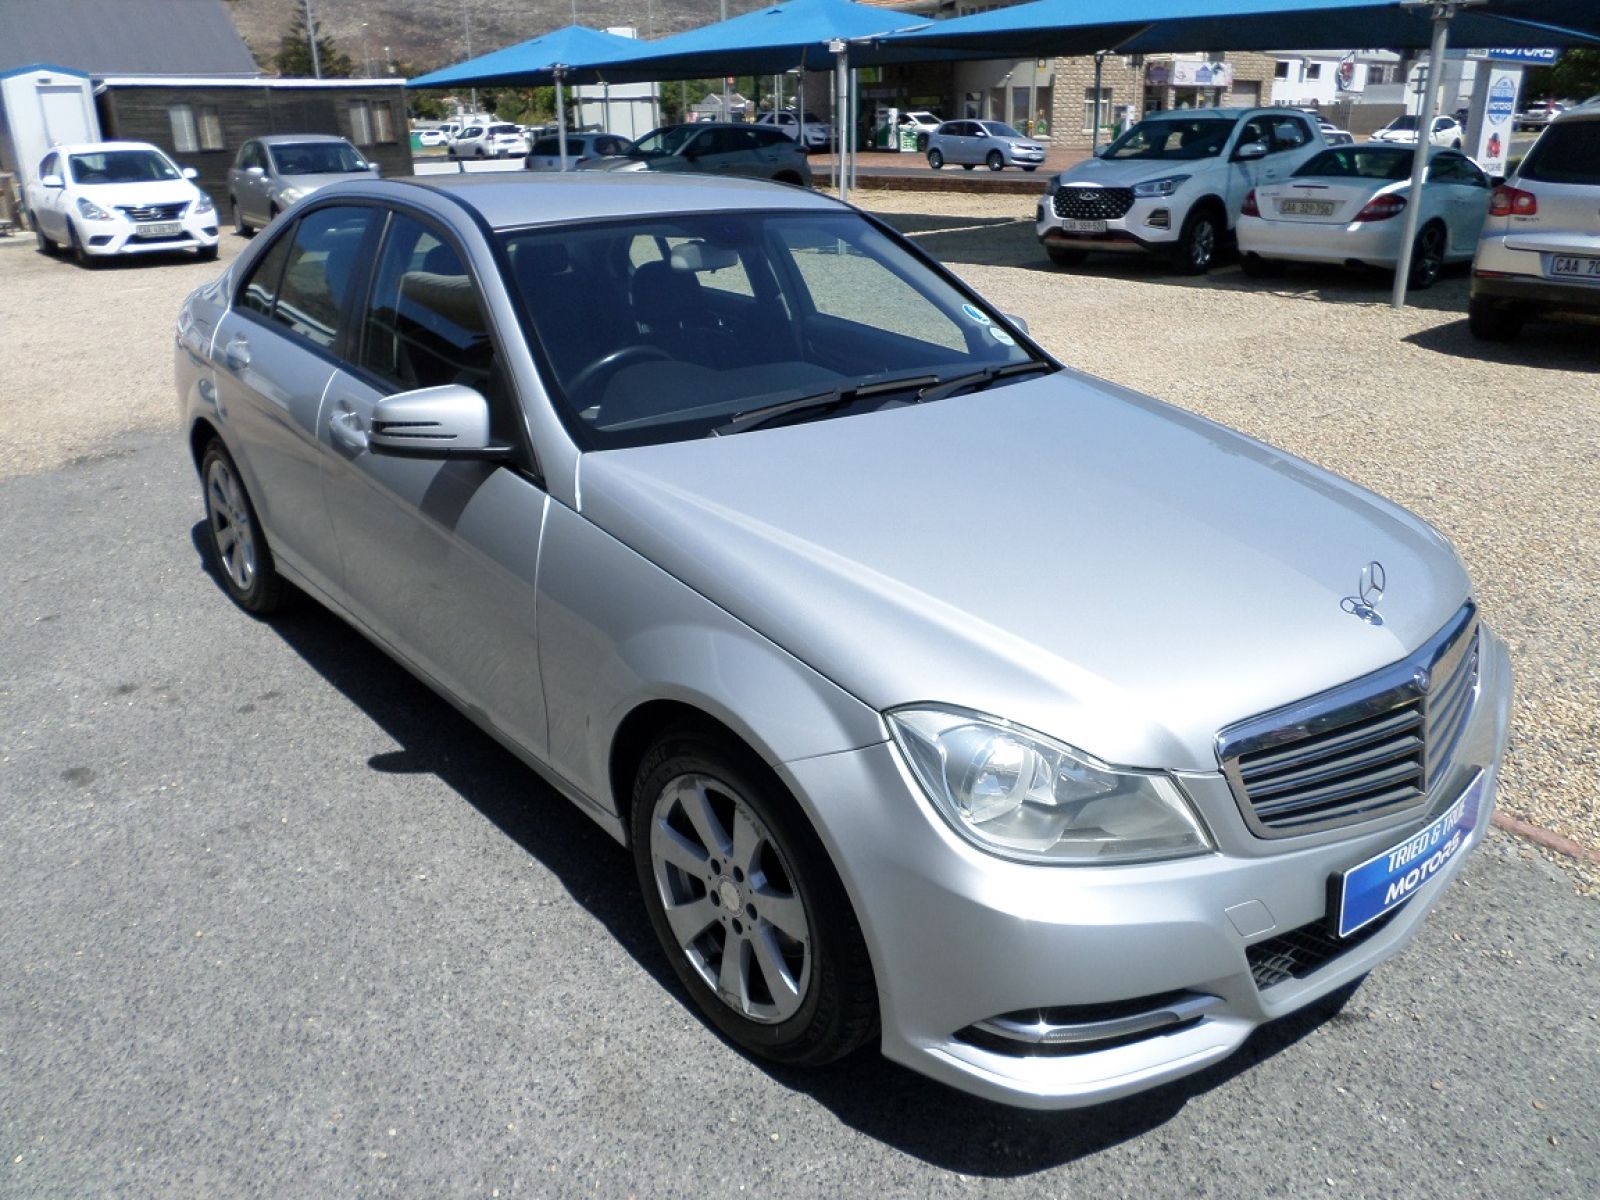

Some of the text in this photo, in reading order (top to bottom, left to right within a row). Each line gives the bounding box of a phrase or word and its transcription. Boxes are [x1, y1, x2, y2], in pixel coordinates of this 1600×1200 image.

[1556, 259, 1579, 273] CAA
[1384, 829, 1461, 905] MOTORS
[1388, 834, 1430, 873] TRIED
[1430, 822, 1441, 845] &
